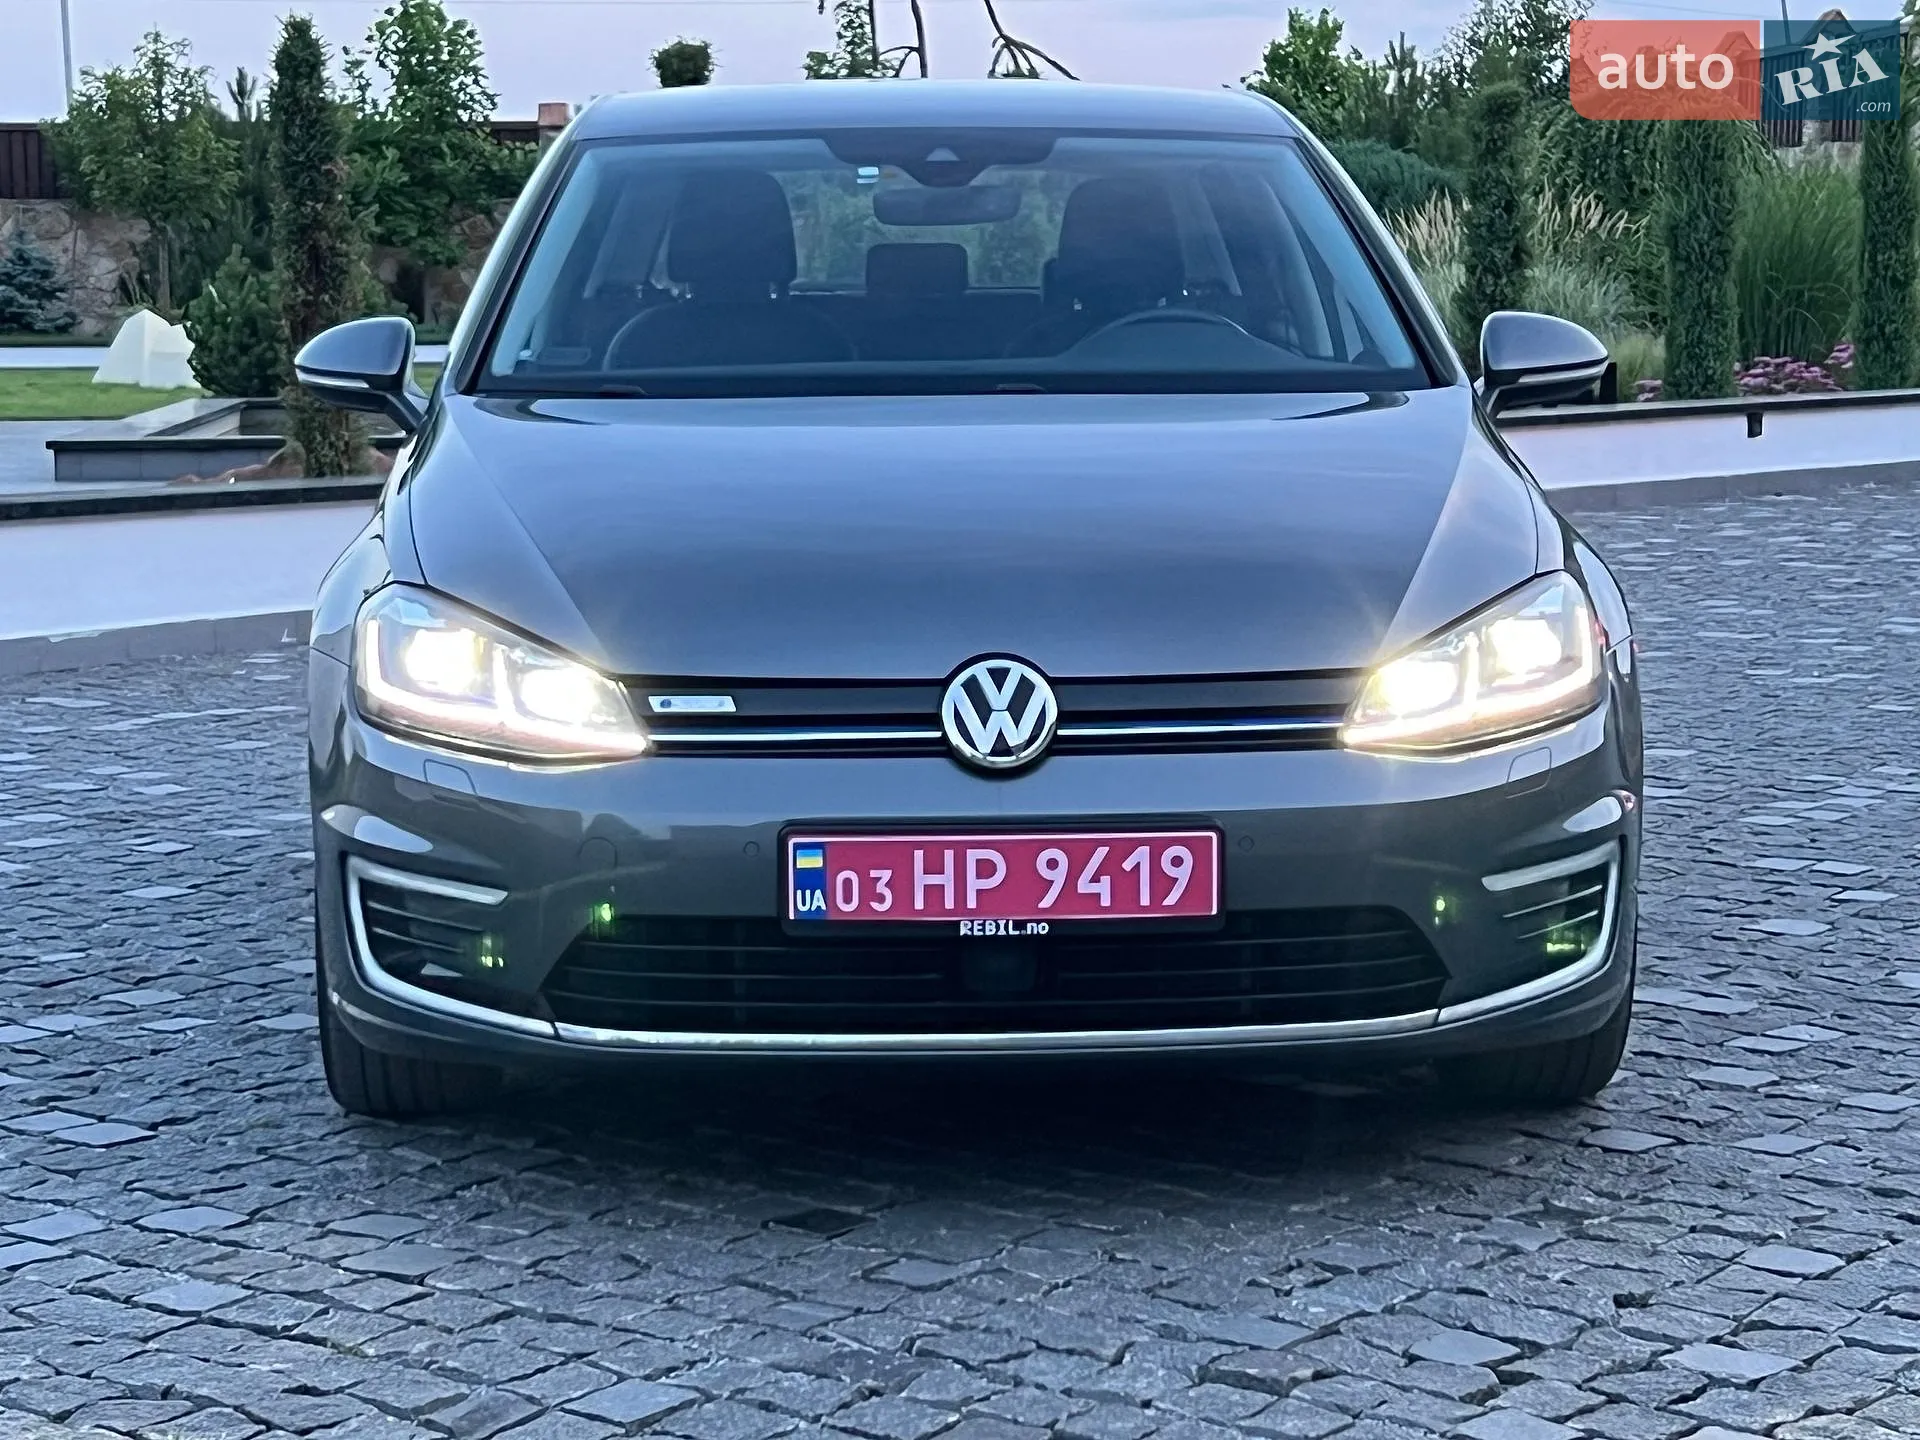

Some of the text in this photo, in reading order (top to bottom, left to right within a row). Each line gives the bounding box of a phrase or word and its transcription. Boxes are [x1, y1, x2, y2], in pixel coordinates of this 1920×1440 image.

[796, 889, 826, 911] UA
[835, 845, 1195, 912] 03 HP 9419
